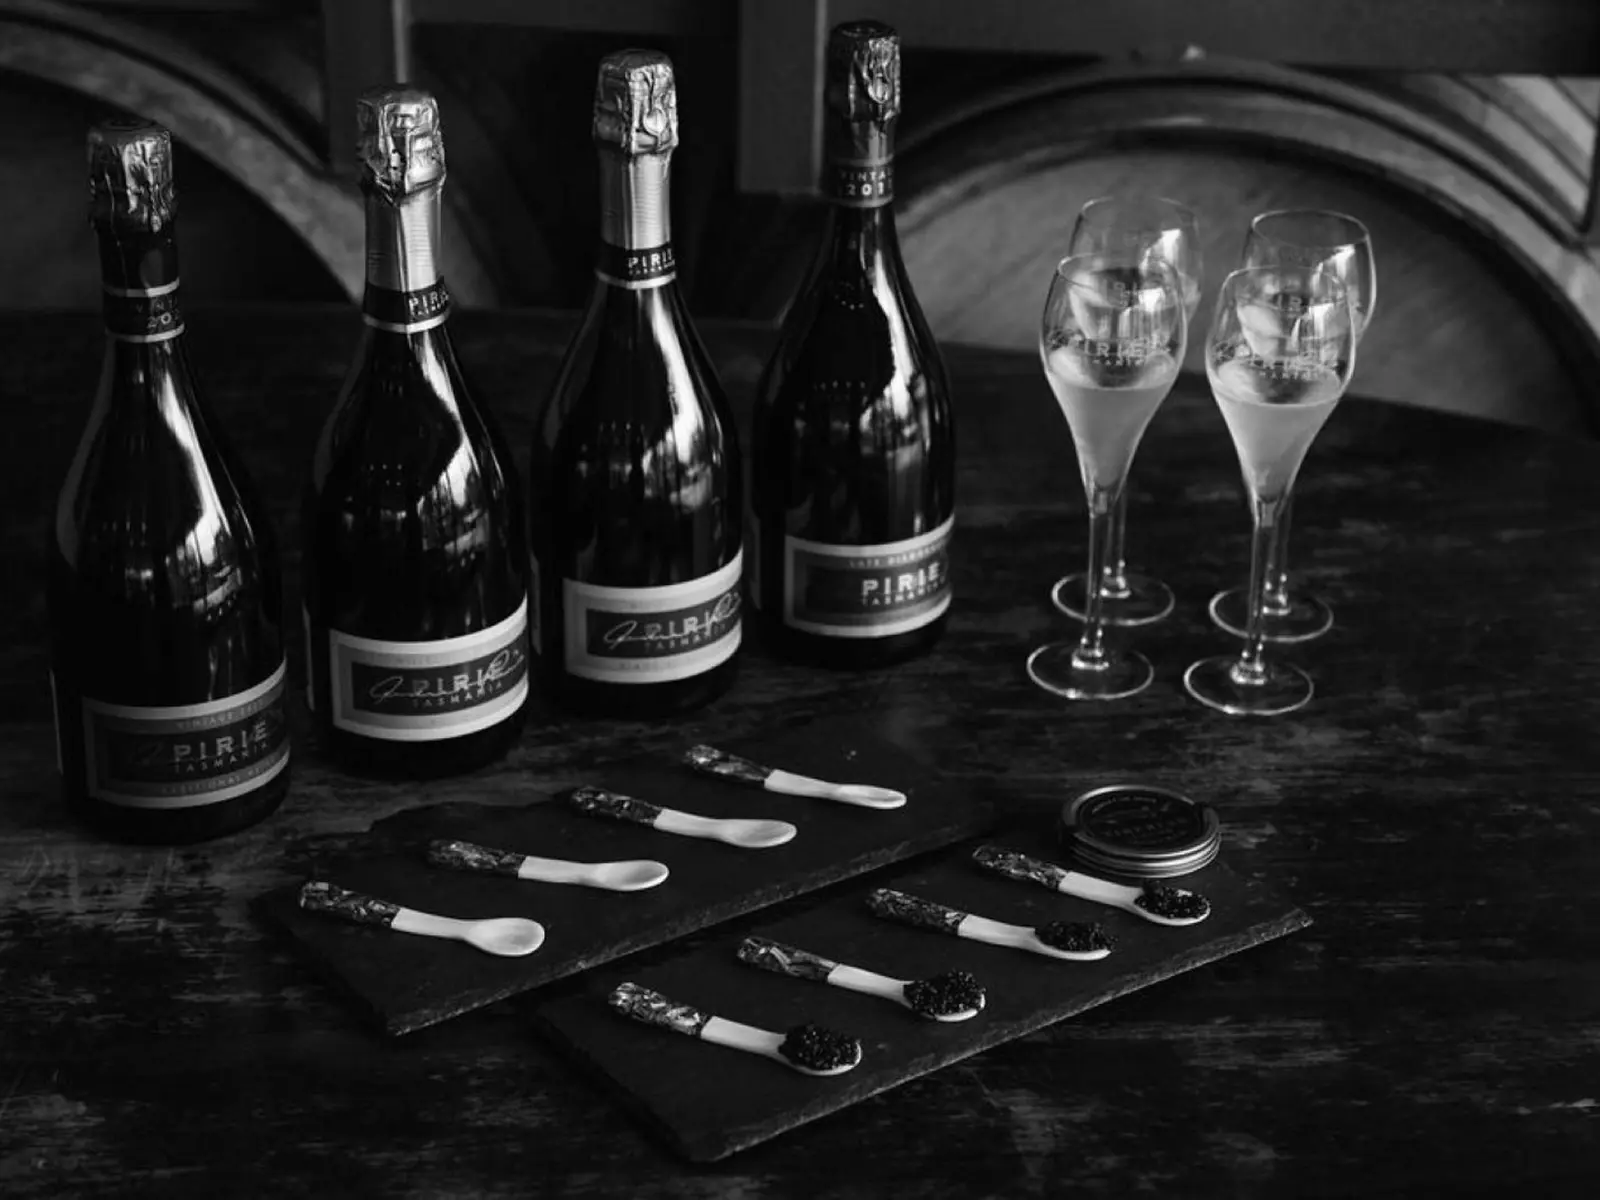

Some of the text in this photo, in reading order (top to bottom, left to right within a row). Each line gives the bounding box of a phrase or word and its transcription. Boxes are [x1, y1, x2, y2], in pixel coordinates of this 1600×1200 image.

[844, 180, 892, 197] 201
[861, 561, 941, 597] PIRIE
[411, 681, 503, 709] TASMANIA
[172, 718, 270, 762] PIRIE
[173, 741, 270, 775] TASMANIA
